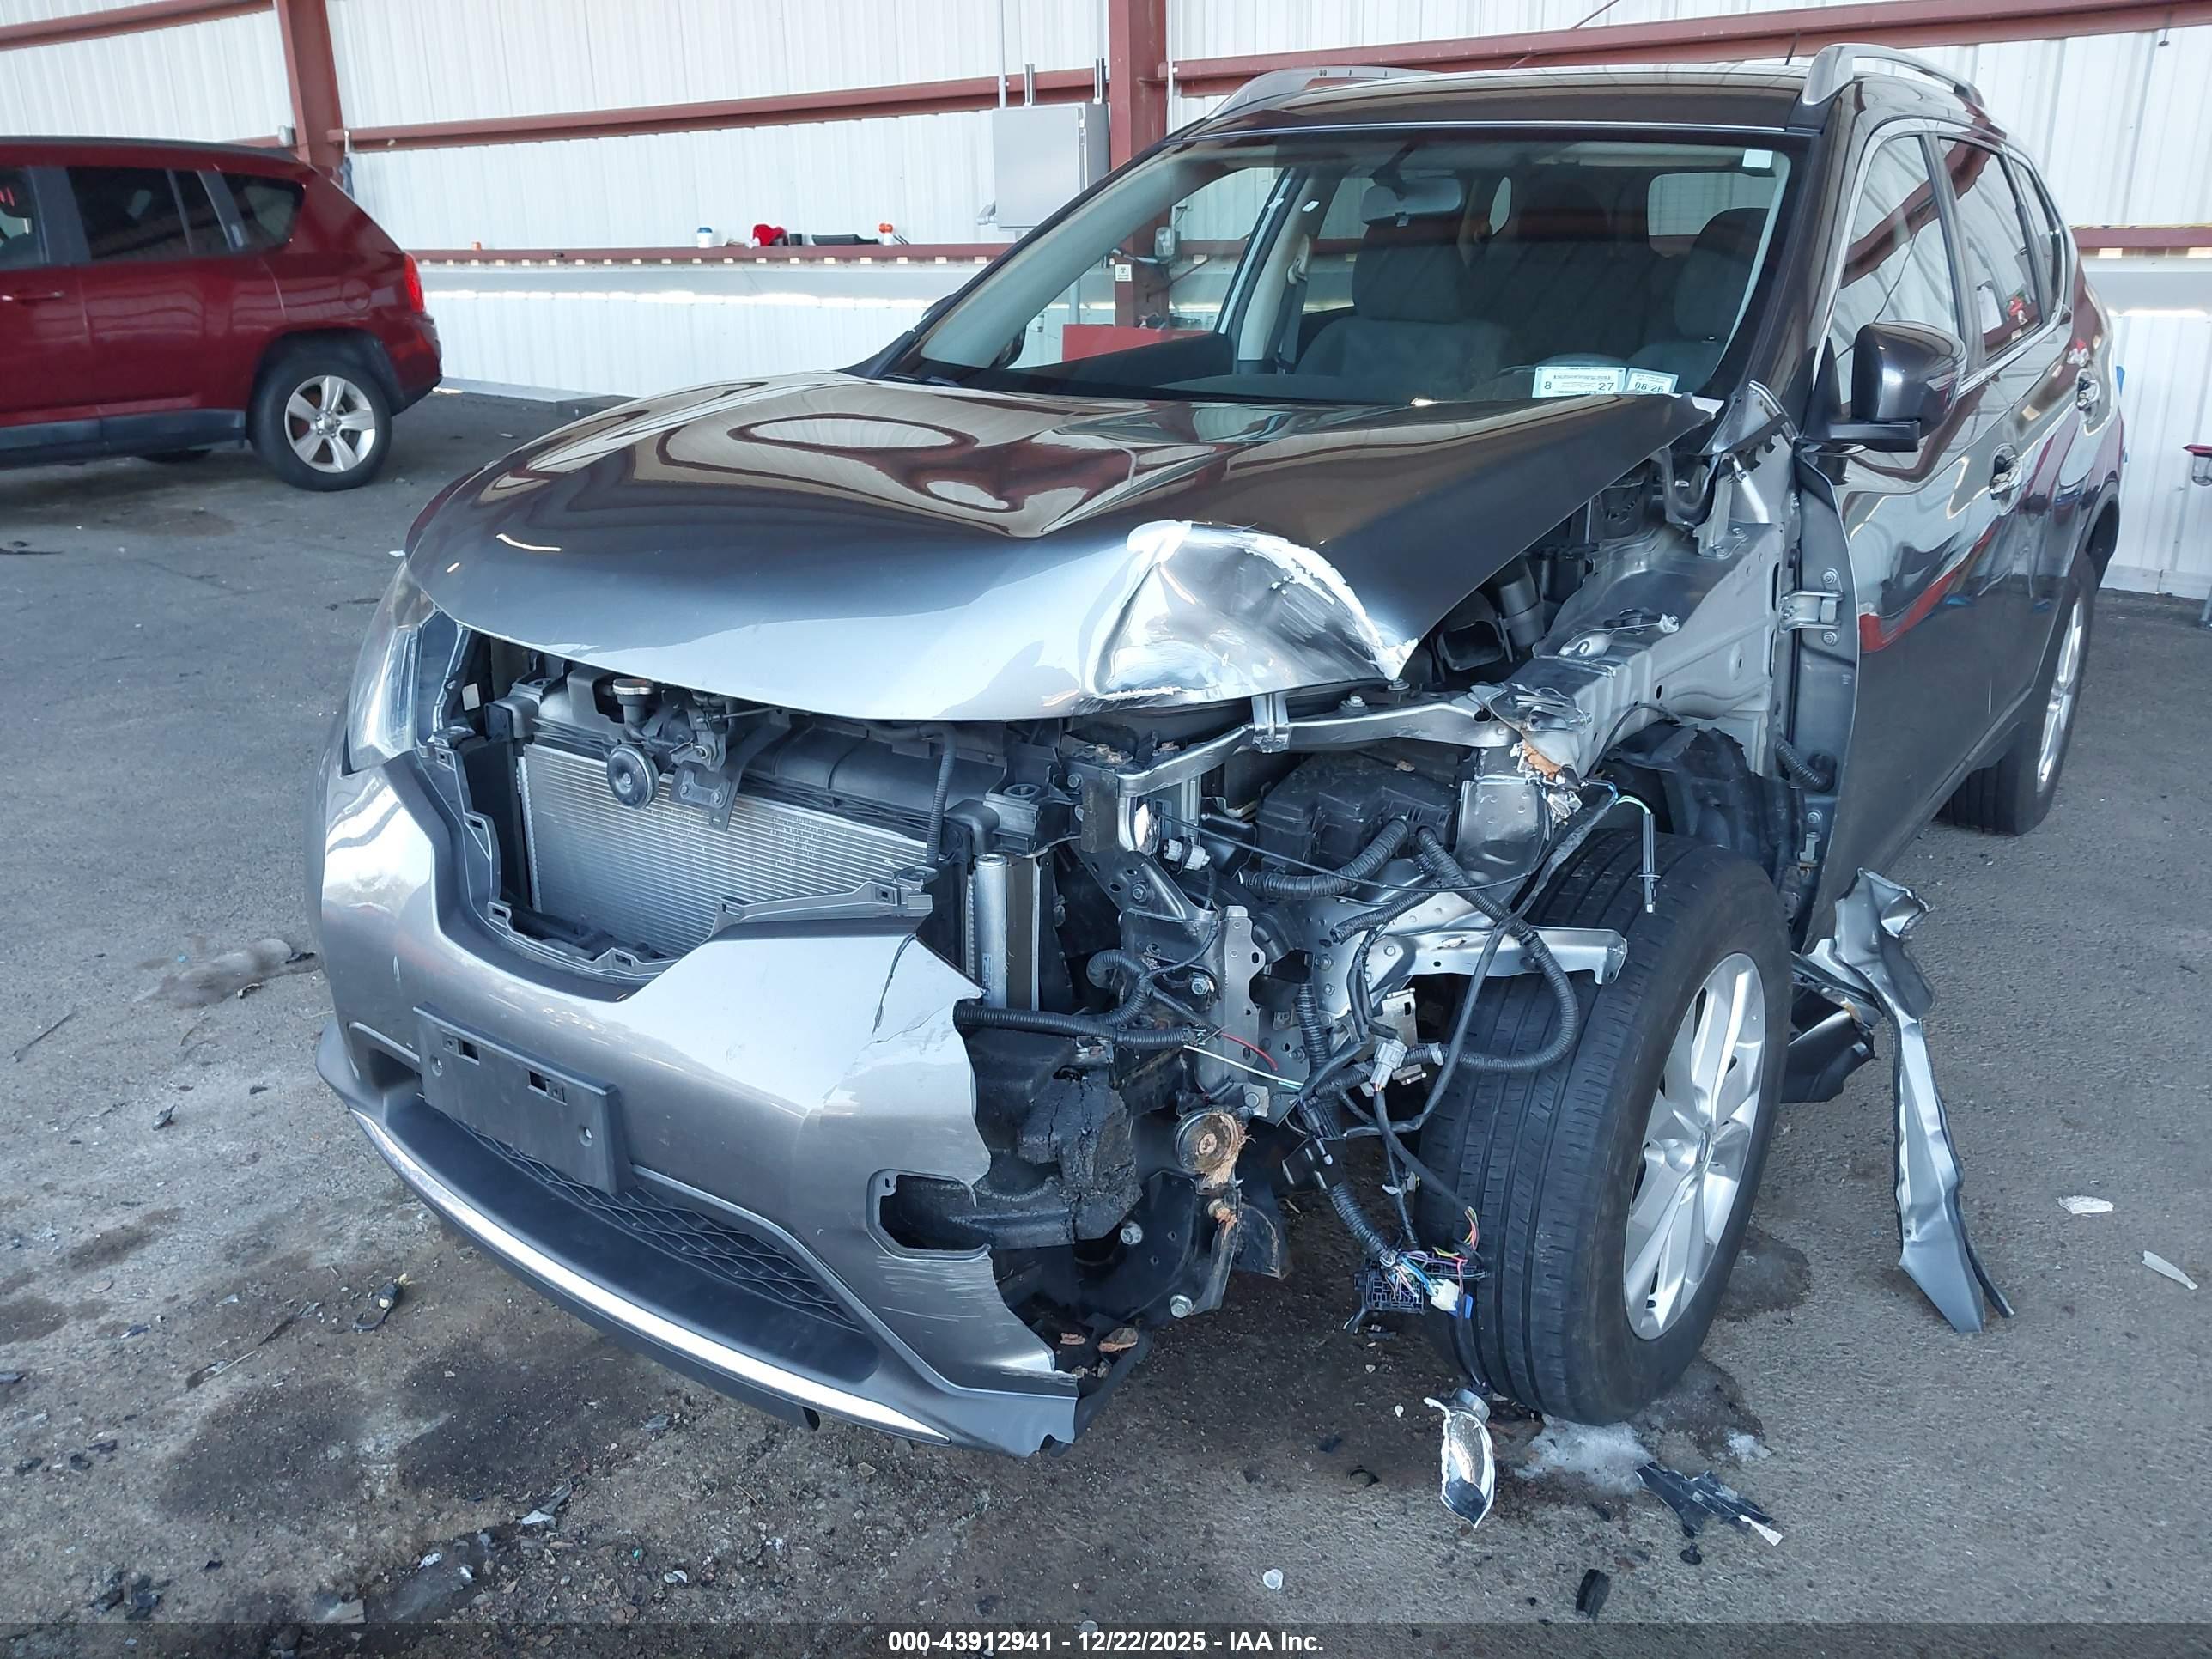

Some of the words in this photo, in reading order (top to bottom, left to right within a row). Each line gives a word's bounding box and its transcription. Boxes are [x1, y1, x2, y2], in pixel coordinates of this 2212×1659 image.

[1544, 380, 1552, 390] 8
[1598, 381, 1615, 392] 27
[1634, 381, 1648, 391] 08
[1650, 384, 1664, 393] 26
